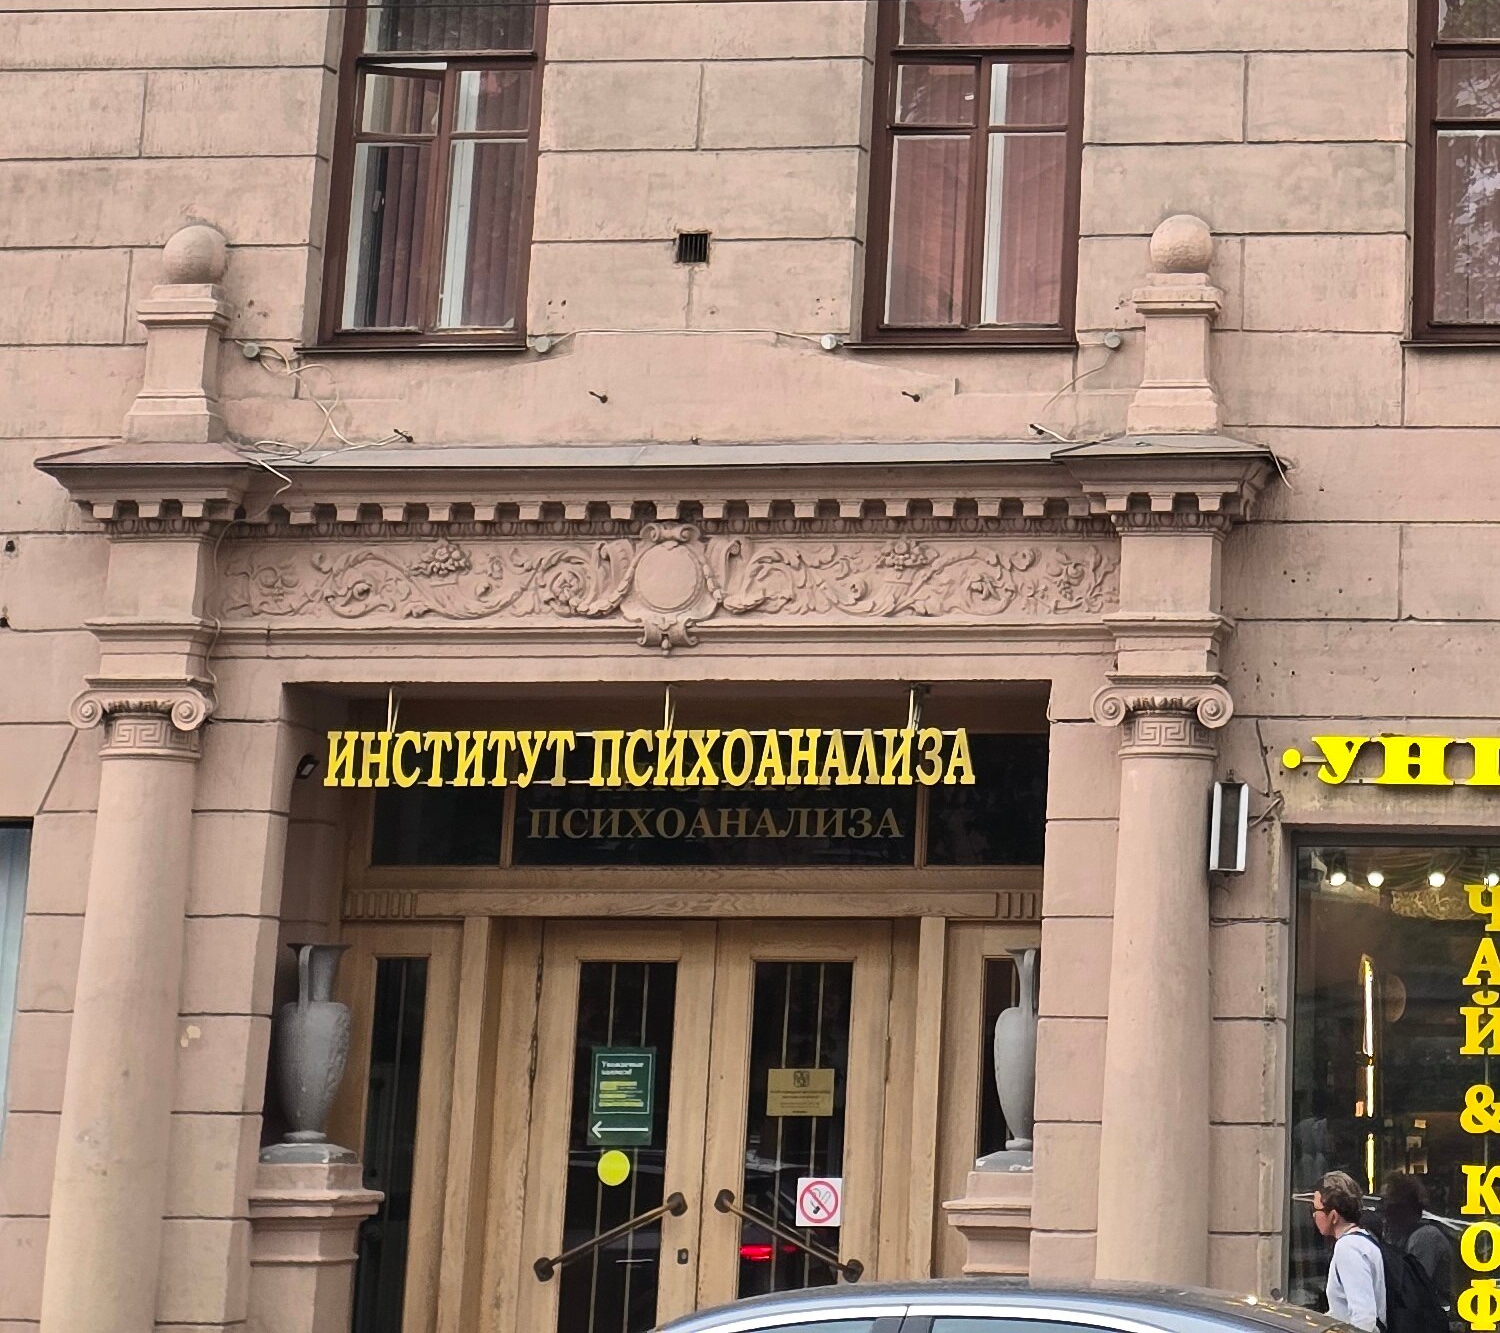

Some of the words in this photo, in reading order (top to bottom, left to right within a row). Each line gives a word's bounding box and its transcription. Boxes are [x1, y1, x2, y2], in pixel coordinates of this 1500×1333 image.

[324, 731, 575, 788] ИНСТИТУТ
[590, 728, 976, 787] ПСИХОАНАЛИЗА
[527, 808, 904, 839] ПСИХОАНАЛИЗА
